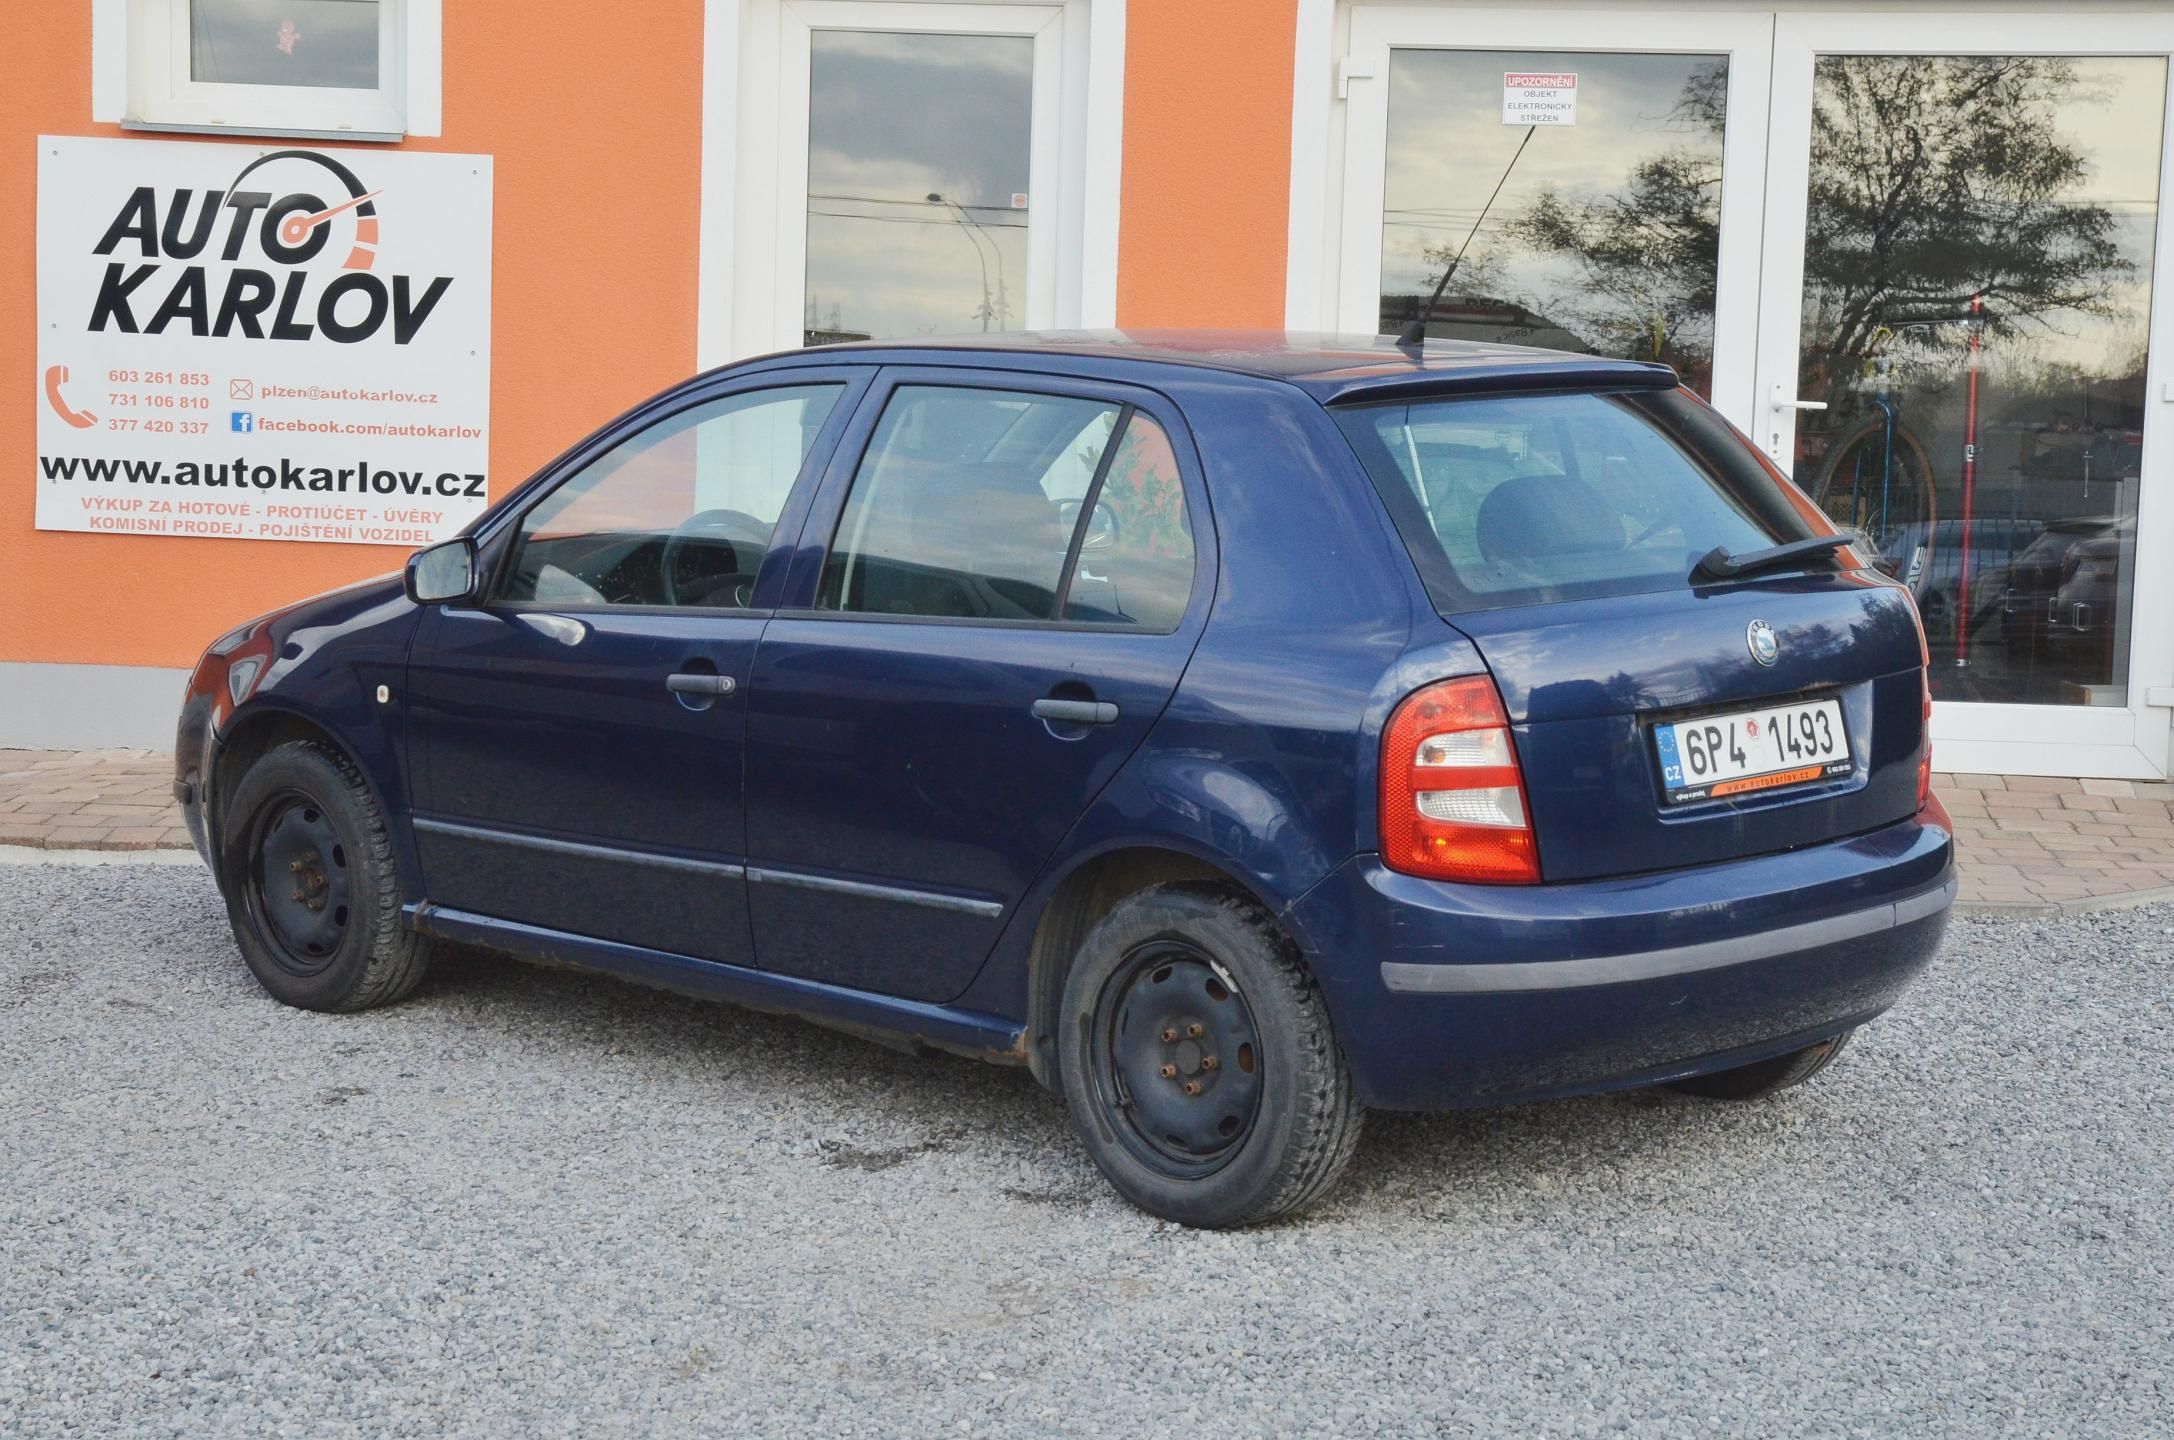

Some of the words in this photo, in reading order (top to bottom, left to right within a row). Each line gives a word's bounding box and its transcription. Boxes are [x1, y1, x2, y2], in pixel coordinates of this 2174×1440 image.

[1523, 90, 1557, 98] OBJEKT
[1507, 102, 1572, 110] ELEKTRONICKY
[92, 186, 332, 265] AUTO
[87, 262, 455, 345] KARLOV
[109, 370, 139, 383] 603
[144, 371, 174, 385] 261
[179, 373, 210, 386] 853
[109, 393, 137, 406] 731
[144, 395, 174, 408] 106
[179, 397, 209, 409] 810
[261, 385, 438, 404] plzen@autokarlov.cz
[108, 419, 138, 431] 377
[144, 420, 174, 433] 420
[179, 422, 209, 434] 337
[258, 417, 482, 438] facebook.com/autokarlov
[39, 456, 486, 498] www.autokarlov.cz
[81, 496, 143, 512] VÝKUP
[149, 500, 172, 513] ZA
[178, 499, 251, 517] HOTOVÉ
[266, 504, 368, 521] PROTIÚČET
[384, 507, 444, 524] ÚVĚRY
[90, 516, 167, 532] KOMISNÍ
[173, 519, 243, 535] PRODEJ
[259, 522, 353, 539] POJIŠTĚNÍ
[359, 527, 435, 543] VOZIDEL
[1686, 722, 1746, 776] 6P4
[1768, 709, 1833, 762] 1493
[1664, 765, 1682, 781] CZ
[1727, 771, 1810, 792] www.autokarlov.cz
